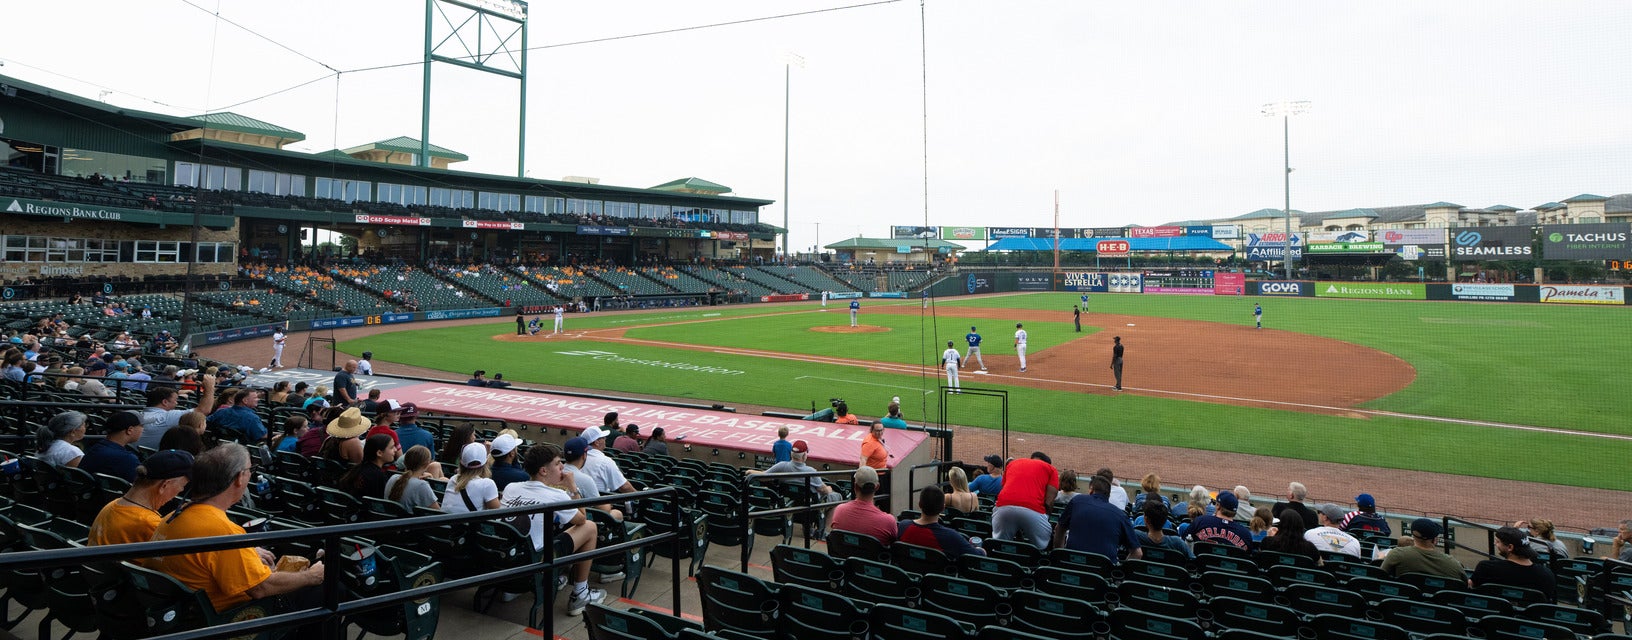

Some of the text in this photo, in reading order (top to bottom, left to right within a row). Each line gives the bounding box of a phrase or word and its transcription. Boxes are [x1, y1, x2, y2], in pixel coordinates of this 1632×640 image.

[26, 203, 120, 220] REGIONS BANK CLUB
[384, 217, 401, 225] Scrap
[1261, 233, 1290, 242] ARRO
[1566, 232, 1627, 242] TACHUS
[1456, 246, 1532, 256] SEAMLESS
[1065, 272, 1098, 280] VIVE TU
[1261, 282, 1300, 293] GOYA
[1341, 286, 1413, 296] REGIONS BANK
[1541, 286, 1599, 302] Pamela
[592, 354, 745, 375] Constellation
[422, 386, 868, 442] ENGINEERING IS LIKE BASEBALL
[460, 401, 537, 415] WANT
[526, 409, 581, 420] THE
[669, 425, 724, 439] THE
